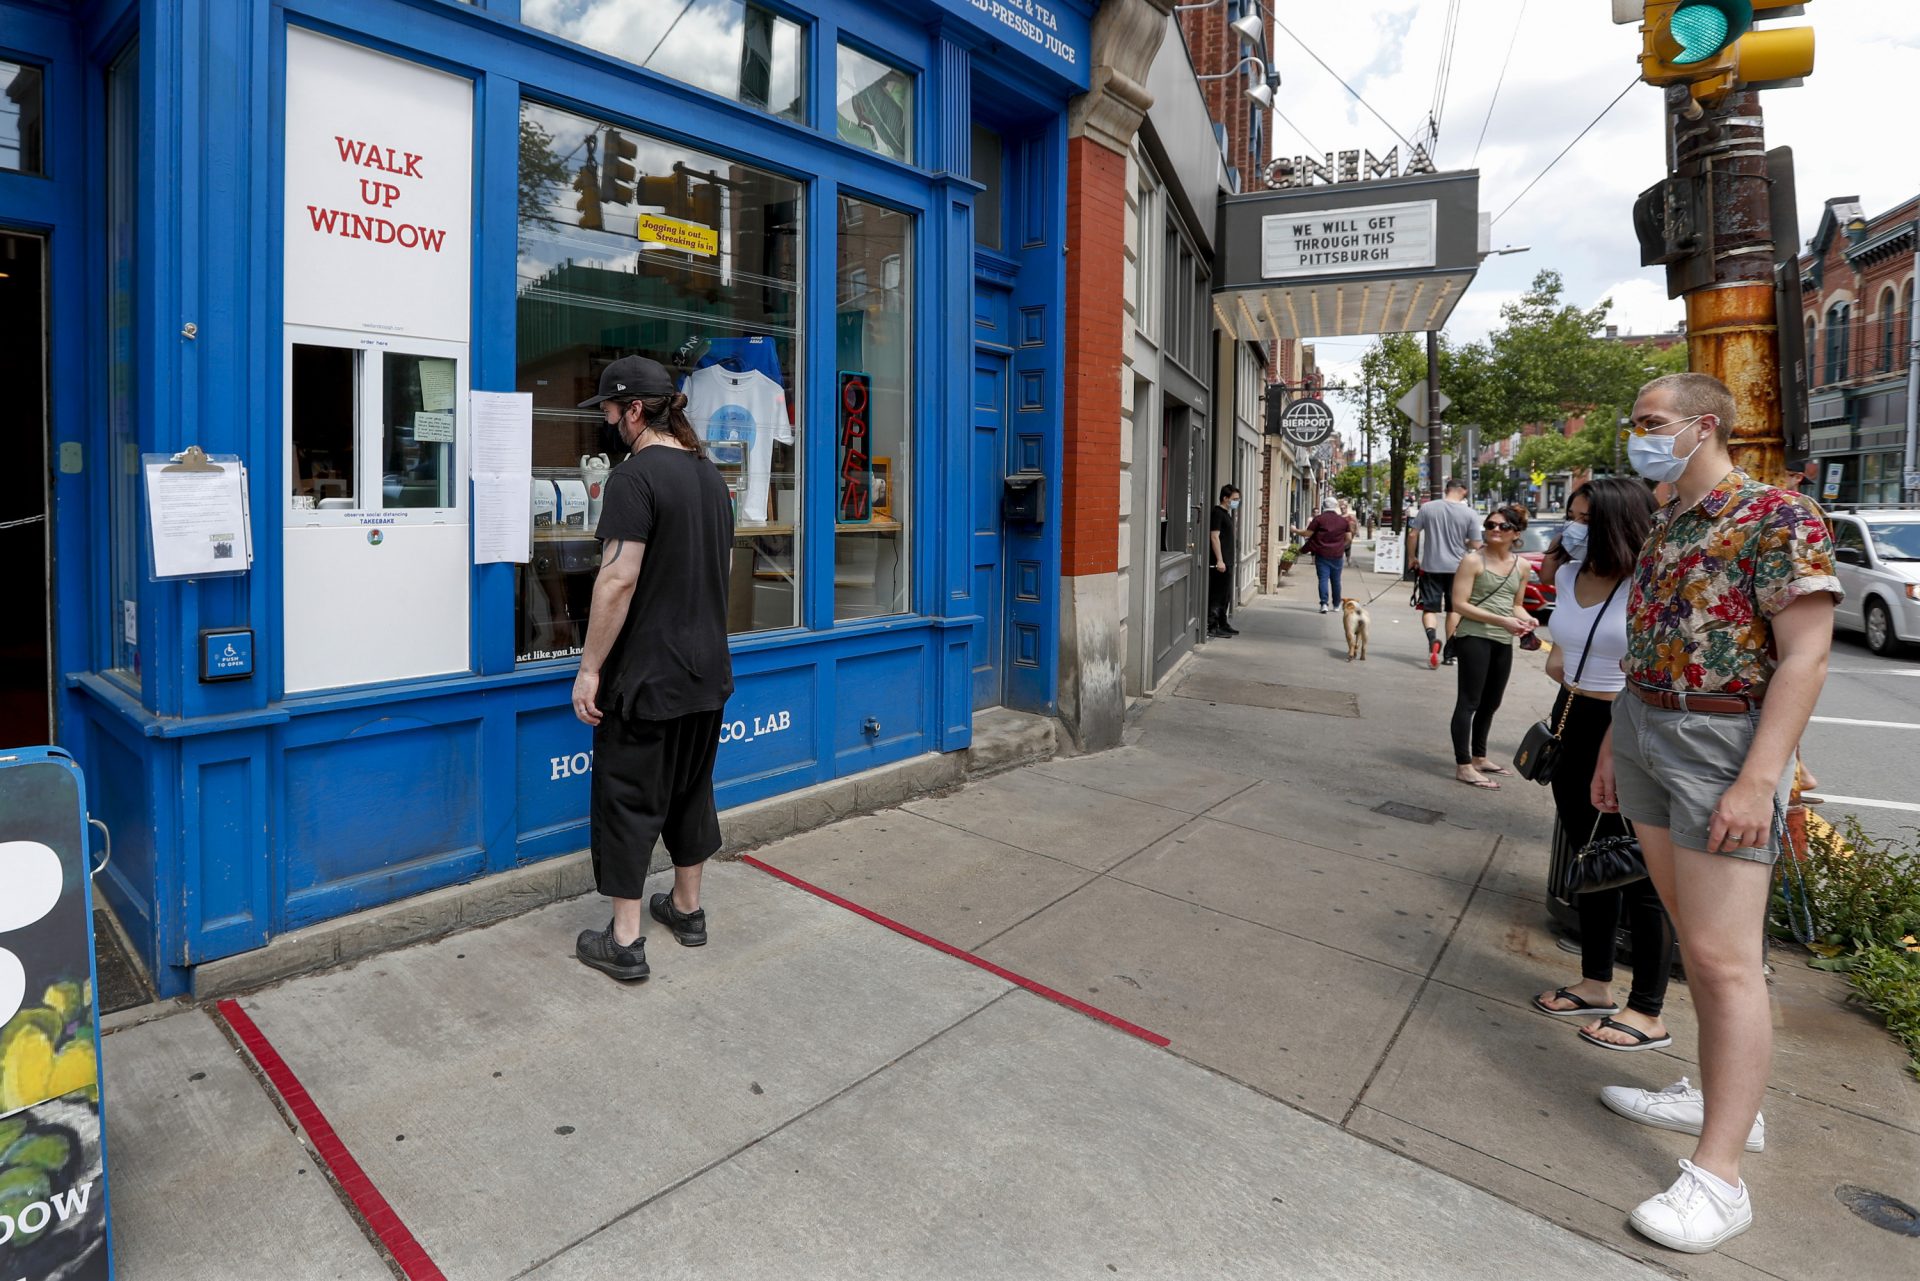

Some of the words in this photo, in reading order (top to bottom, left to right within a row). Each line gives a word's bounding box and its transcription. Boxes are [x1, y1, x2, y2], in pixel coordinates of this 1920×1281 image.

[1025, 0, 1034, 17] &
[1035, 4, 1058, 31] TEA
[1045, 33, 1076, 64] JUICE
[334, 136, 423, 179] WALK
[1264, 142, 1438, 190] CINEMA
[360, 178, 401, 208] UP
[307, 205, 446, 253] WINDOW
[642, 220, 677, 235] Jogging
[679, 227, 686, 235] is
[688, 231, 708, 241] out...
[1293, 223, 1312, 237] WE
[1323, 219, 1358, 234] WILL
[1368, 216, 1396, 230] GET
[656, 231, 696, 249] Streaking
[698, 241, 704, 249] is
[706, 242, 714, 251] in
[1294, 234, 1360, 251] THROUGH
[1364, 231, 1395, 245] THIS
[1300, 248, 1389, 266] PITTSBURGH
[1282, 417, 1332, 428] BIERPORT
[841, 380, 868, 520] OPEN
[516, 652, 532, 662] act
[533, 650, 551, 660] like
[552, 649, 568, 659] you
